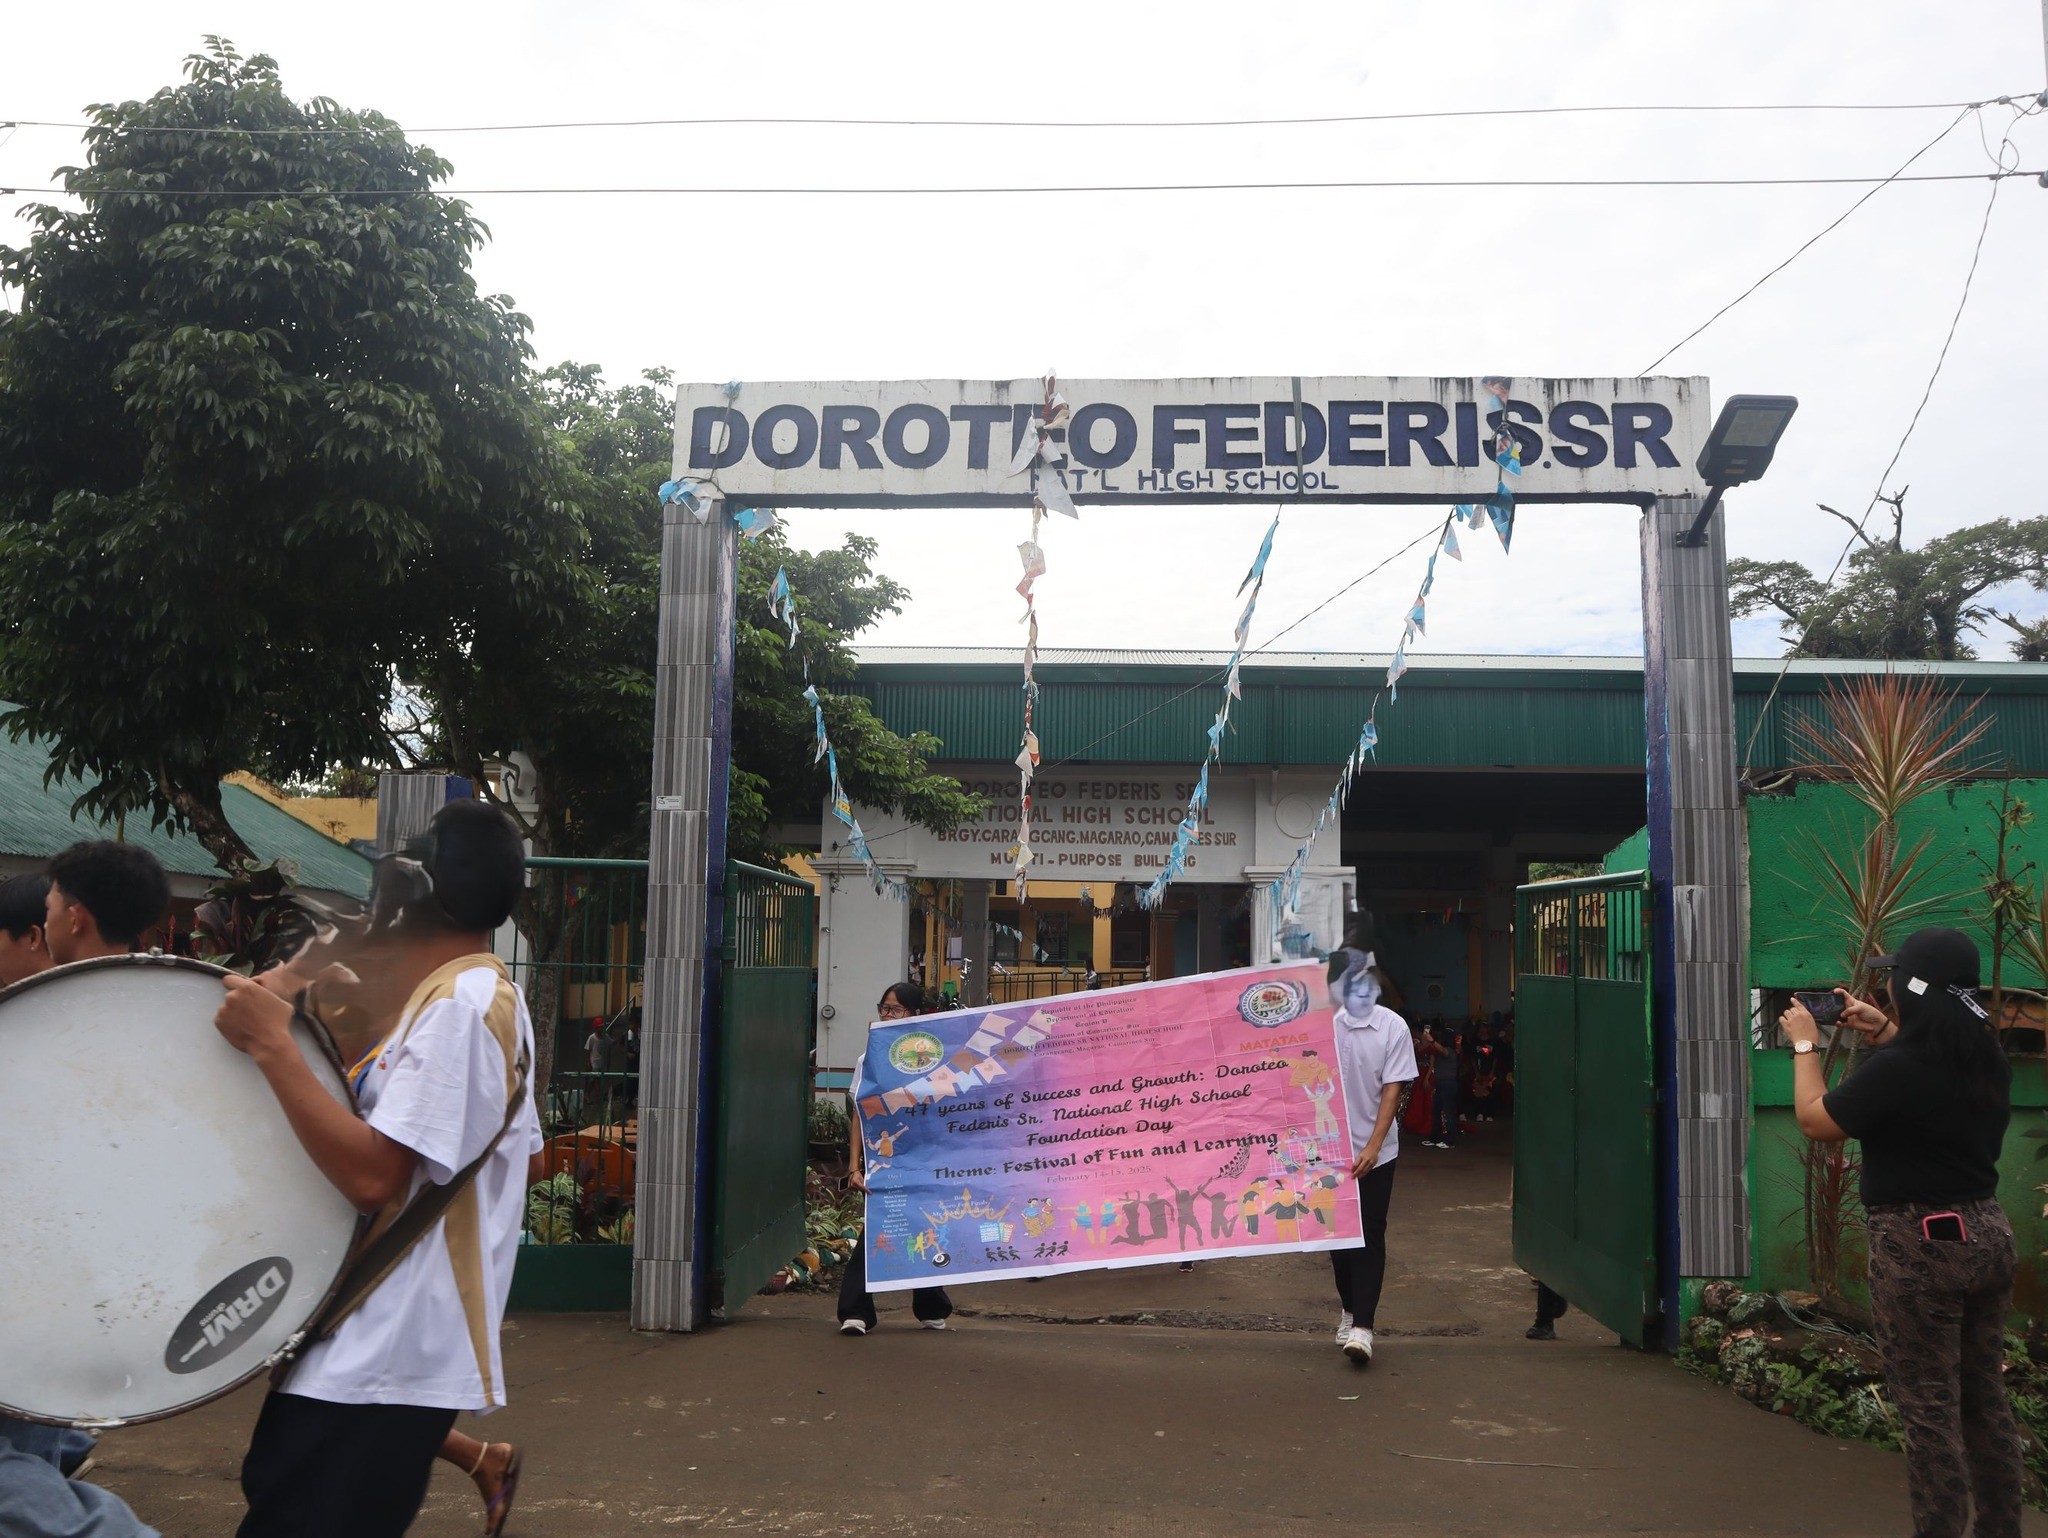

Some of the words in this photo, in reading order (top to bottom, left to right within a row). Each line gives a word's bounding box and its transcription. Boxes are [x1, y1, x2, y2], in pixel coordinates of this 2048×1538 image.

[1138, 470, 1213, 492] HIGH
[1226, 470, 1339, 493] SCHOOL
[1079, 782, 1161, 800] FEDERIS
[1062, 806, 1112, 824] HIGH
[1124, 807, 1215, 825] SCHOL
[1214, 832, 1237, 846] SUR
[990, 852, 1044, 865] MUTI
[1058, 853, 1122, 867] PURPOSE
[1134, 854, 1197, 867] BUILG
[1240, 1033, 1309, 1052] MATATAG
[904, 1102, 928, 1117] 47
[938, 1101, 986, 1118] years
[994, 1093, 1014, 1110] of
[1021, 1087, 1081, 1104] Success
[1089, 1079, 1124, 1095] and
[1132, 1070, 1204, 1093] Growth:
[1215, 1059, 1289, 1078] Doroteo
[946, 1116, 1009, 1134] Federis
[1017, 1112, 1043, 1126] Sr.
[1053, 1100, 1132, 1121] National
[1139, 1094, 1183, 1112] High
[1190, 1084, 1252, 1104] School
[1026, 1123, 1128, 1146] Foundation
[1135, 1119, 1174, 1134] Day
[934, 1165, 997, 1179] Theme:
[1003, 1152, 1077, 1174] Festival
[1083, 1148, 1105, 1165] of
[1109, 1148, 1144, 1161] Fun
[1151, 1140, 1187, 1157] and
[1193, 1132, 1279, 1153] Learning
[1046, 1172, 1090, 1184] February
[1128, 1165, 1152, 1175] 2025
[203, 1266, 286, 1347] DRM
